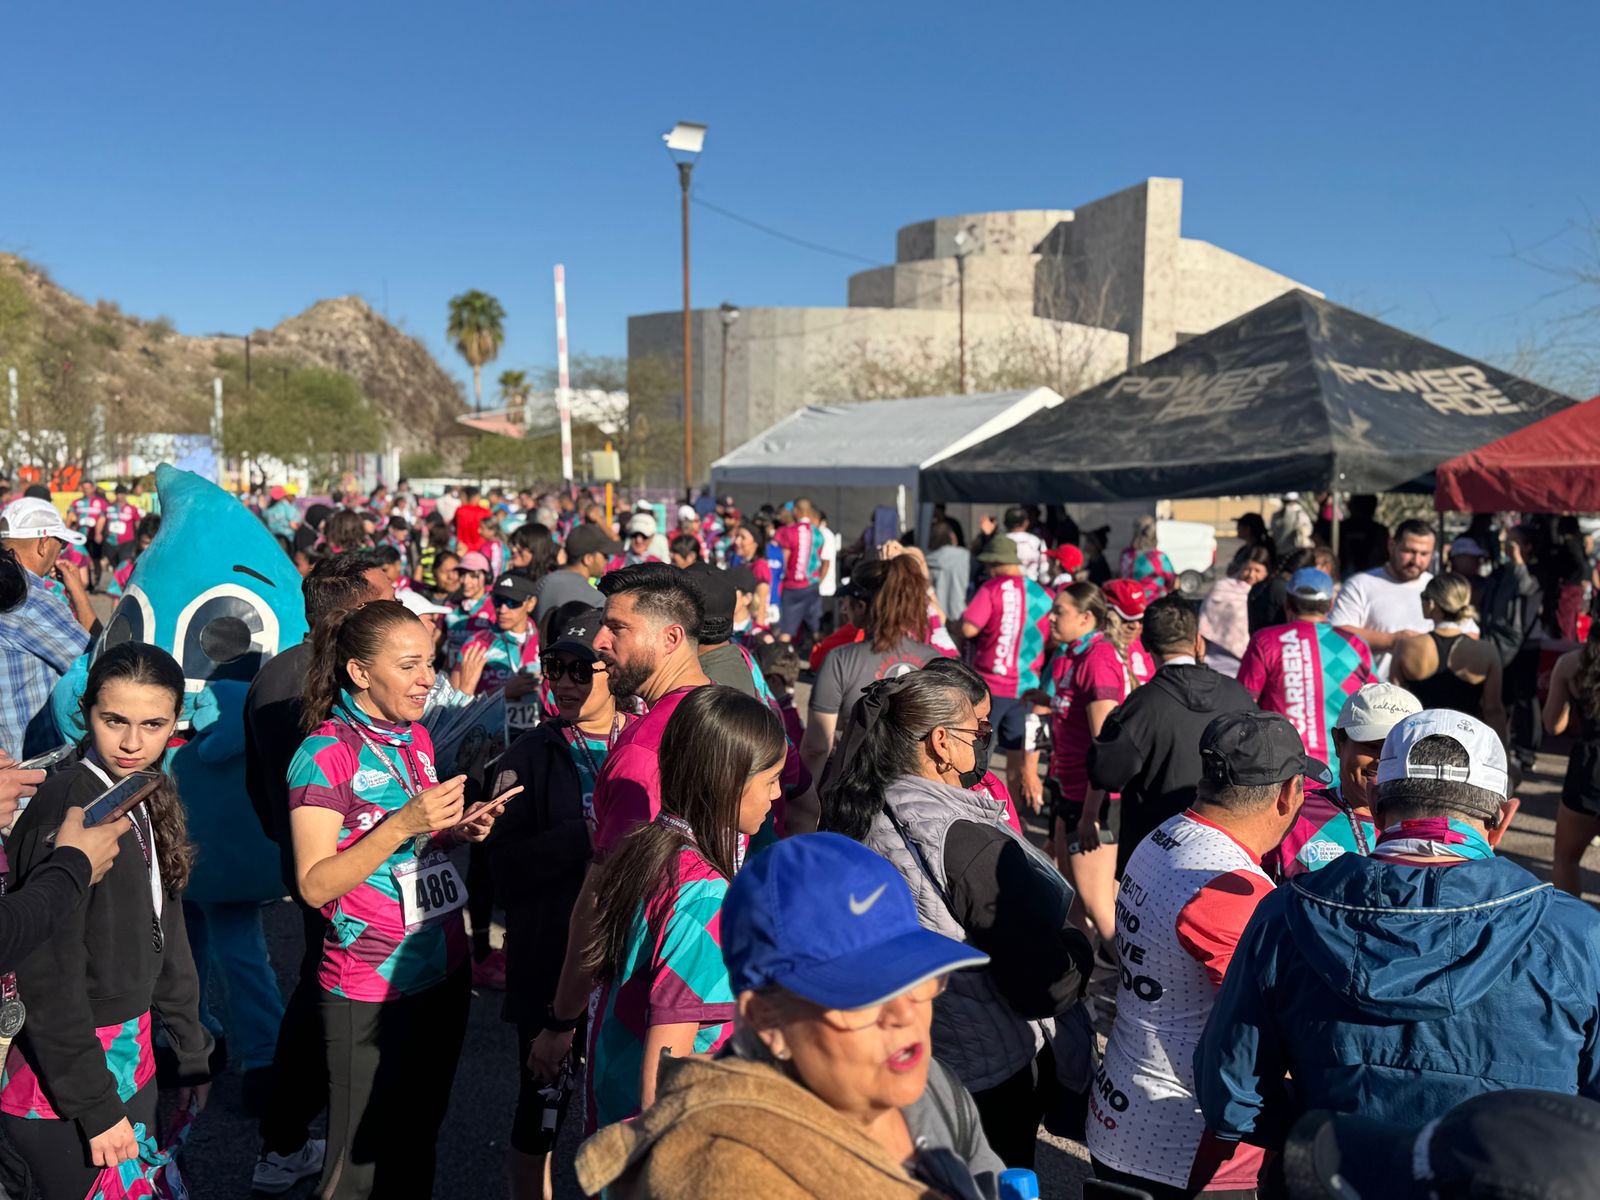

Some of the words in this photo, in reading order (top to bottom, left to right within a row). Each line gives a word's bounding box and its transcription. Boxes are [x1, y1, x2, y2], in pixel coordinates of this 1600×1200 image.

[1105, 361, 1289, 399] POWER
[1328, 360, 1493, 393] POWER
[508, 705, 535, 723] 212
[1151, 829, 1181, 851] BEAT
[415, 869, 458, 912] 486
